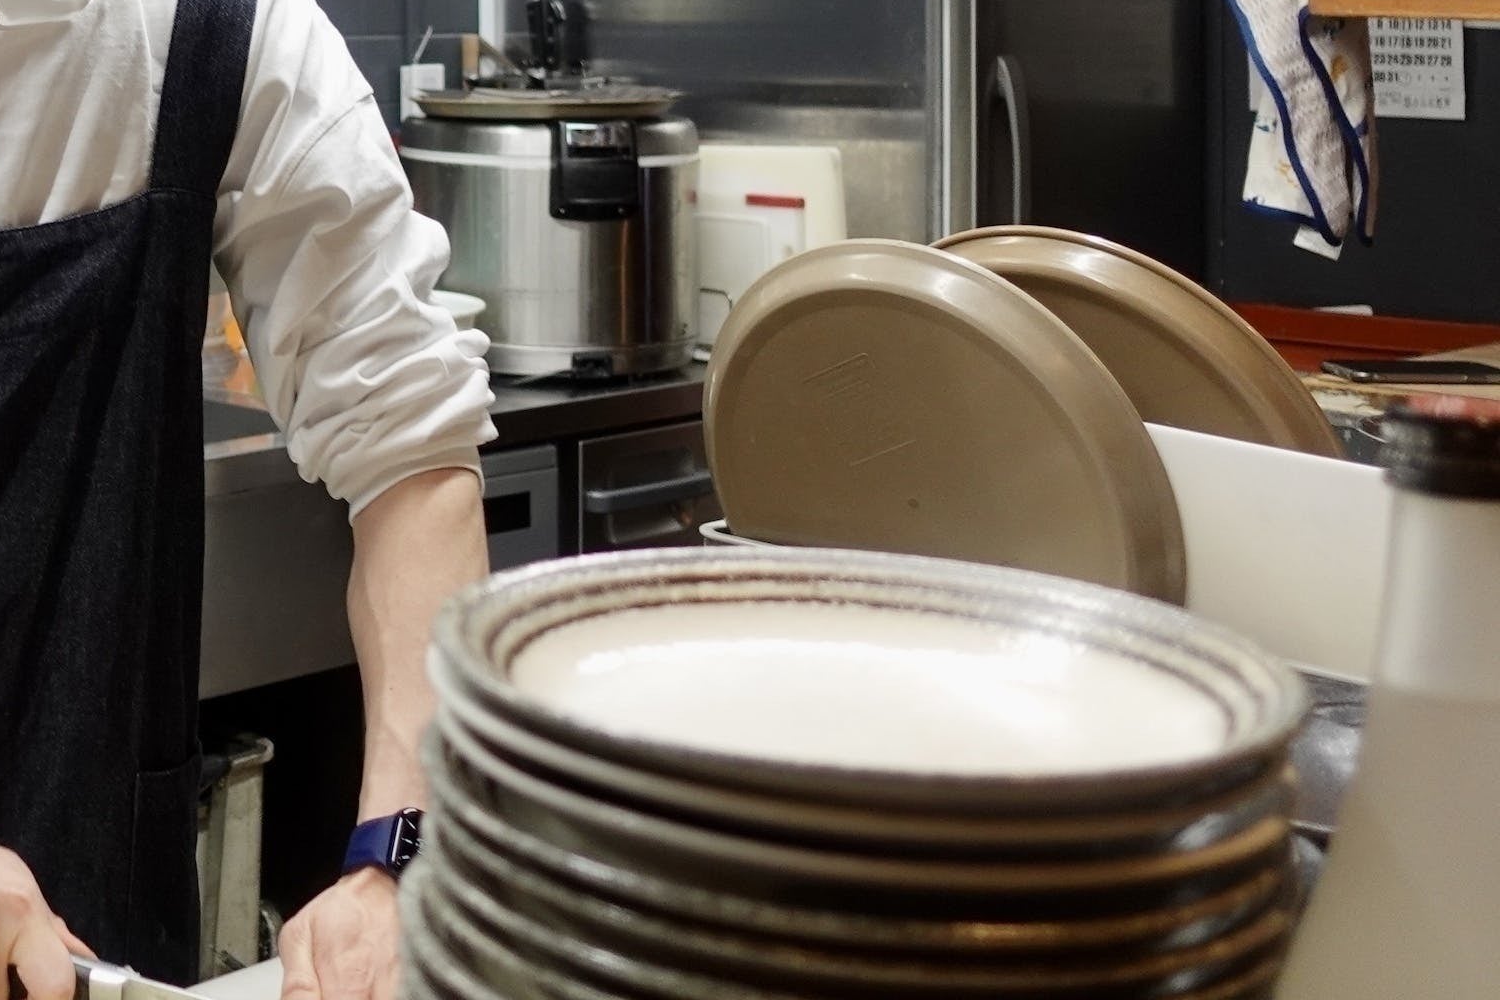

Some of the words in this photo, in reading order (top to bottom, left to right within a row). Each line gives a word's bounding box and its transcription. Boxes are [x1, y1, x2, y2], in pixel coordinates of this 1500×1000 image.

[1388, 36, 1399, 49] 17
[1441, 36, 1452, 49] 21
[1427, 54, 1439, 66] 27
